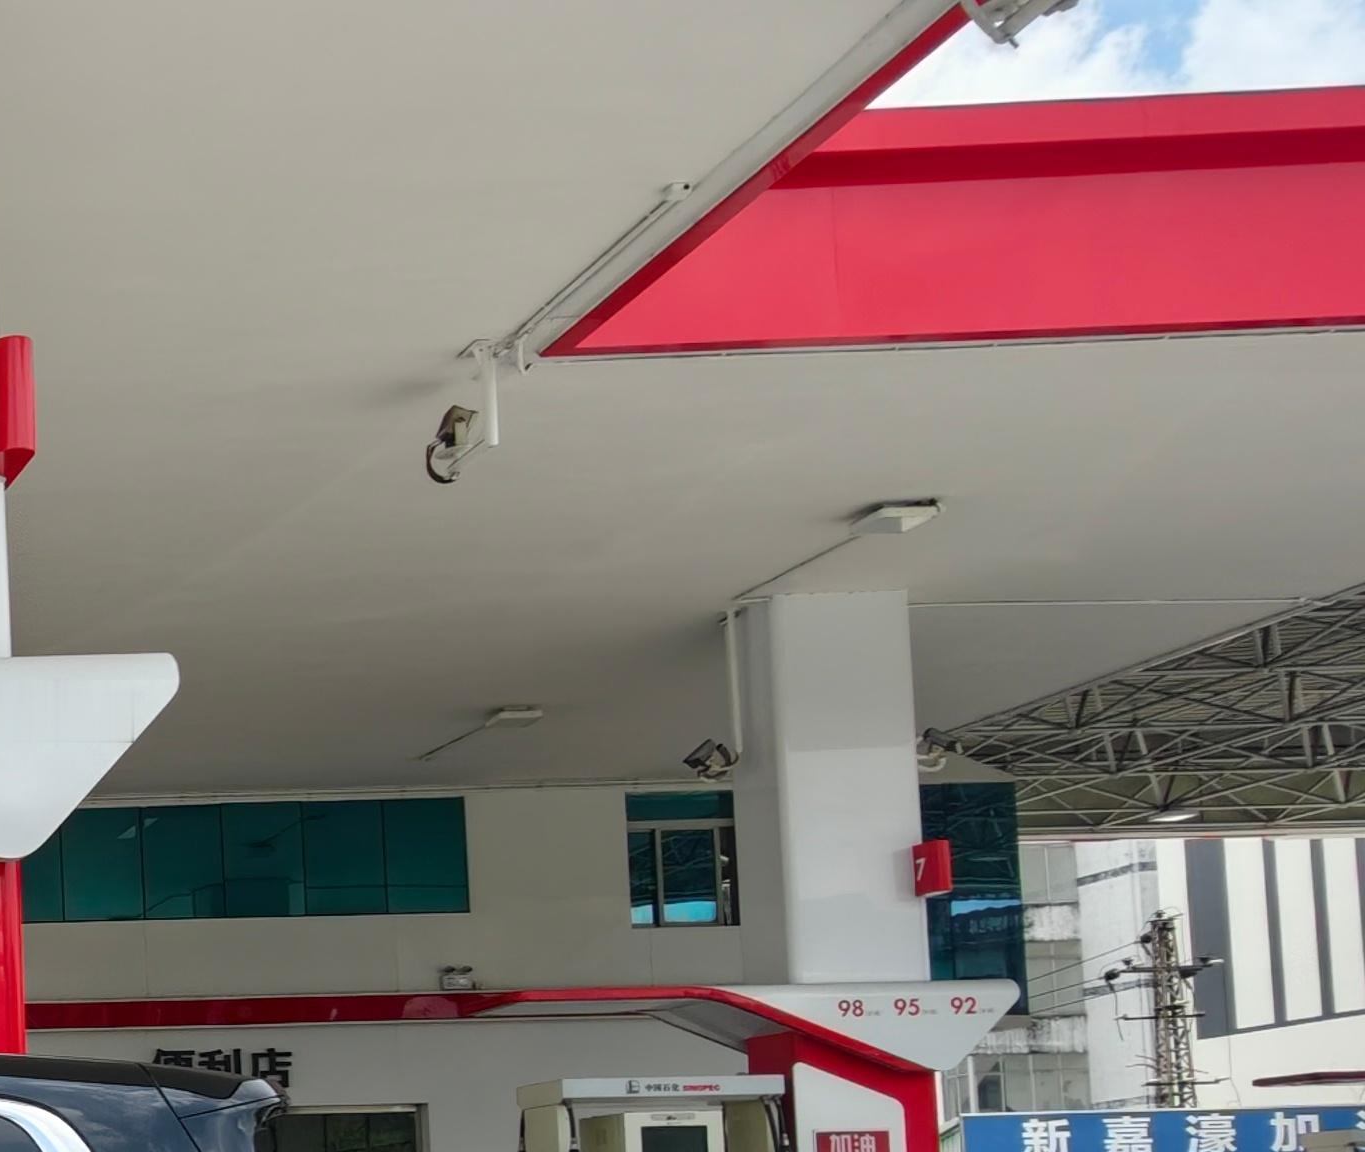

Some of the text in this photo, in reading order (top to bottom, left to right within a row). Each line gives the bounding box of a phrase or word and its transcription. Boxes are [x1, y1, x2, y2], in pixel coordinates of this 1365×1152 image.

[915, 857, 926, 882] 7
[837, 999, 865, 1018] 98
[893, 998, 921, 1016] 95
[950, 996, 977, 1015] 92
